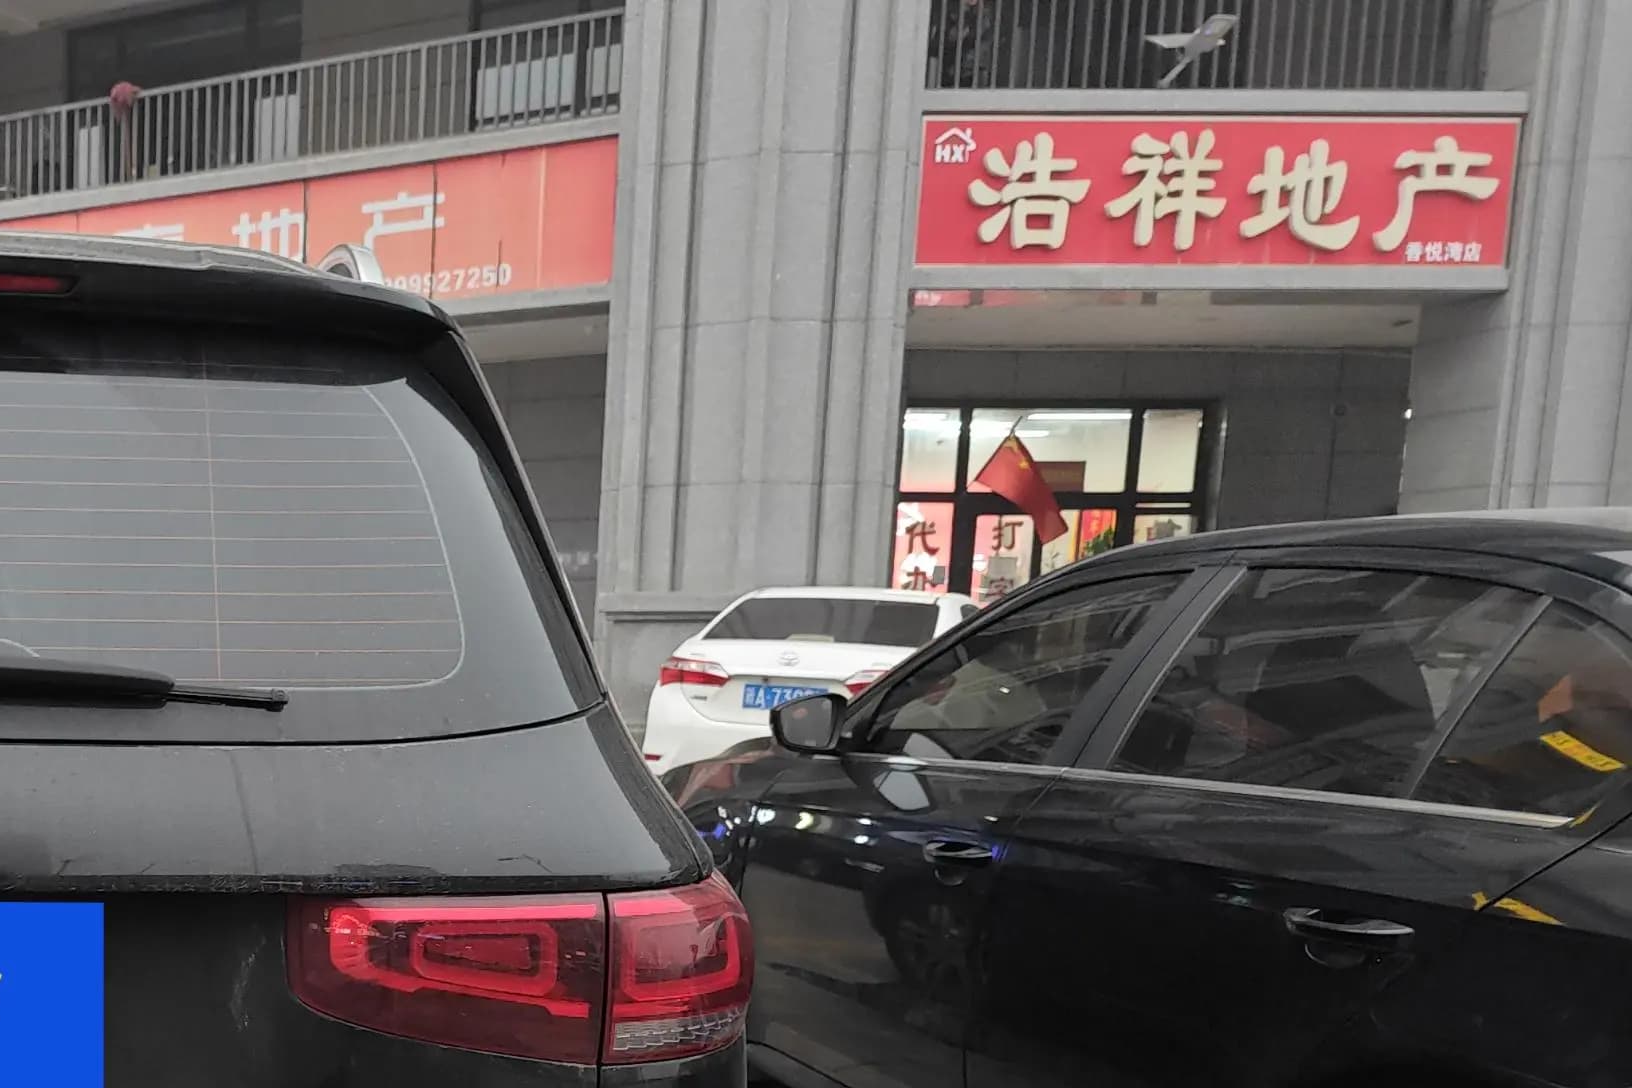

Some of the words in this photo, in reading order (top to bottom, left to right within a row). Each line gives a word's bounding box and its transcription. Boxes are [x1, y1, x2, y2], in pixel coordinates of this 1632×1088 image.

[935, 144, 965, 163] HX
[968, 129, 1500, 252] 浩祥地产
[1405, 242, 1482, 262] 香悦湾店
